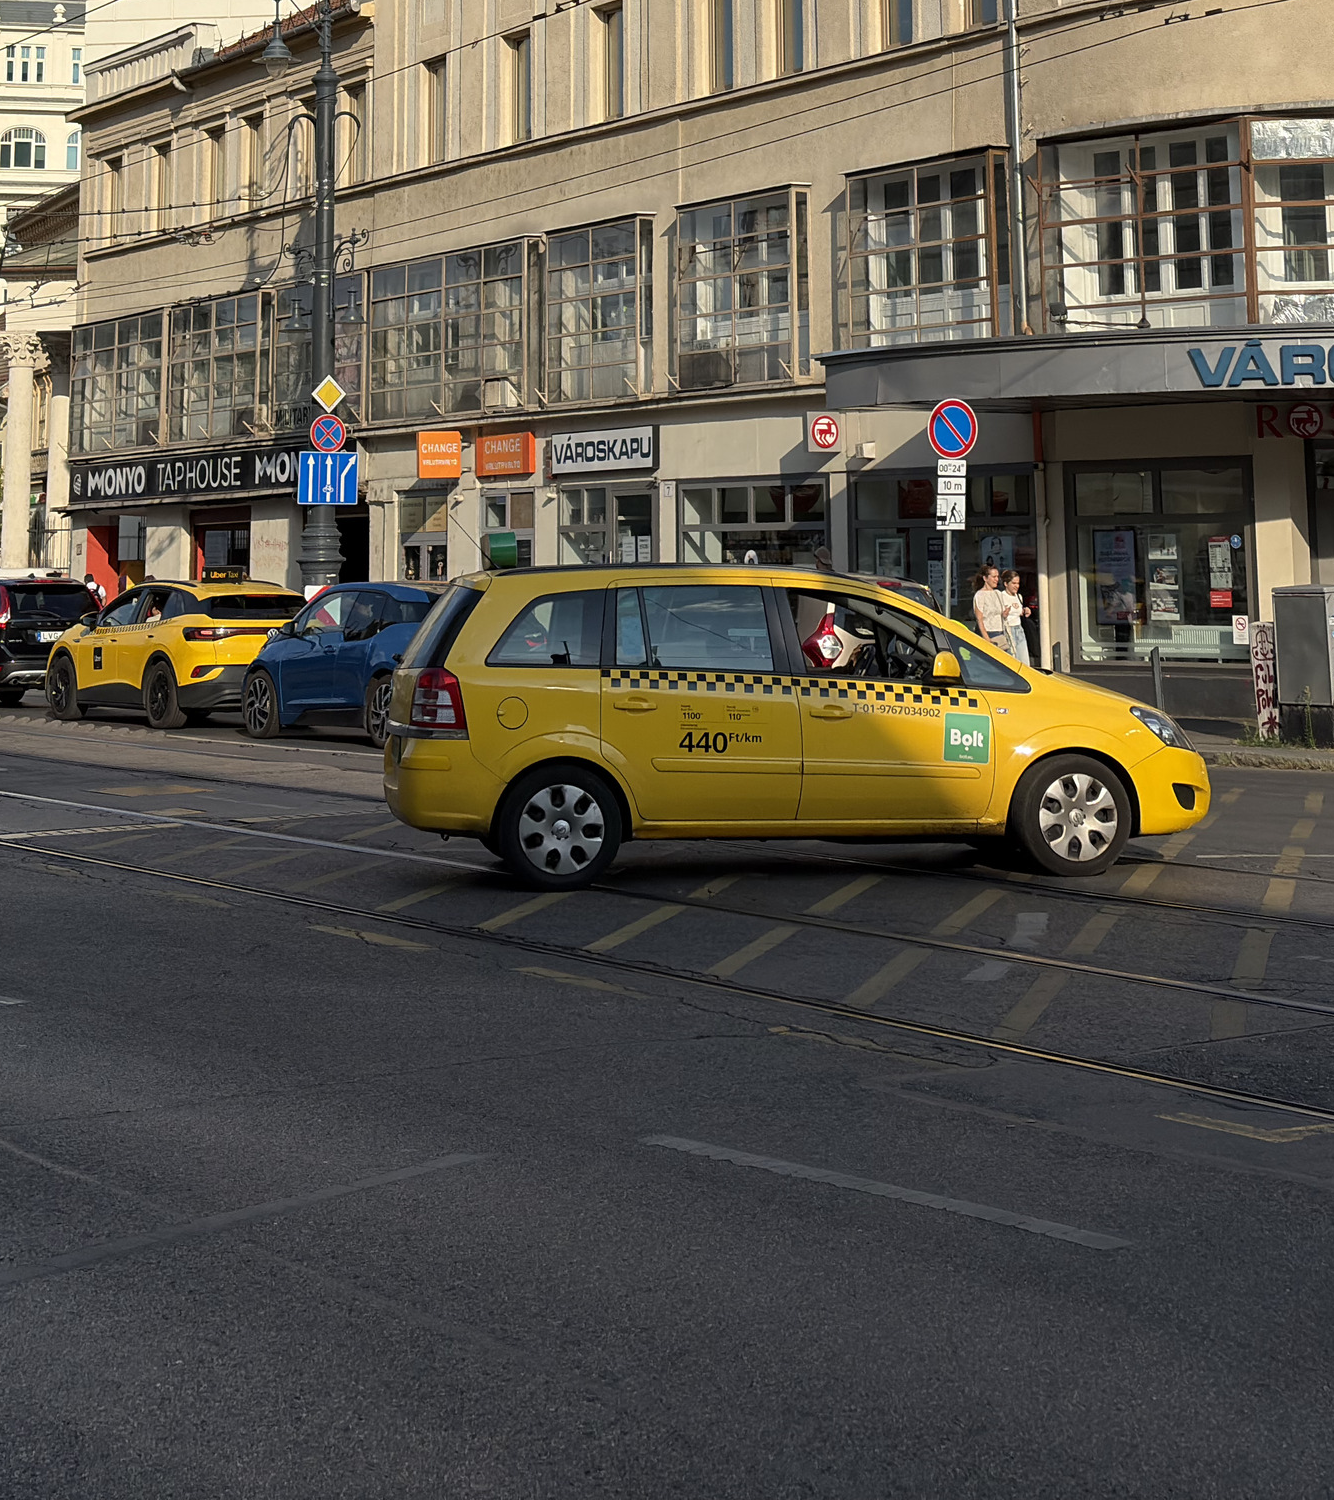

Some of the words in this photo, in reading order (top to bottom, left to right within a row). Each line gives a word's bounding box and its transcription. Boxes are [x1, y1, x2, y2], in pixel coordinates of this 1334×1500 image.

[421, 443, 459, 453] CHANGE
[484, 438, 521, 454] CHANGE
[553, 435, 652, 465] VÁROSKAPU
[87, 465, 146, 497] MONYO
[943, 480, 952, 491] 10
[954, 483, 963, 491] m
[210, 571, 227, 579] Uber
[683, 712, 701, 720] 1100
[853, 703, 941, 717] T-01-9767034902
[679, 731, 728, 753] 440
[729, 732, 762, 743] Ft/km
[950, 728, 984, 751] Bolt
